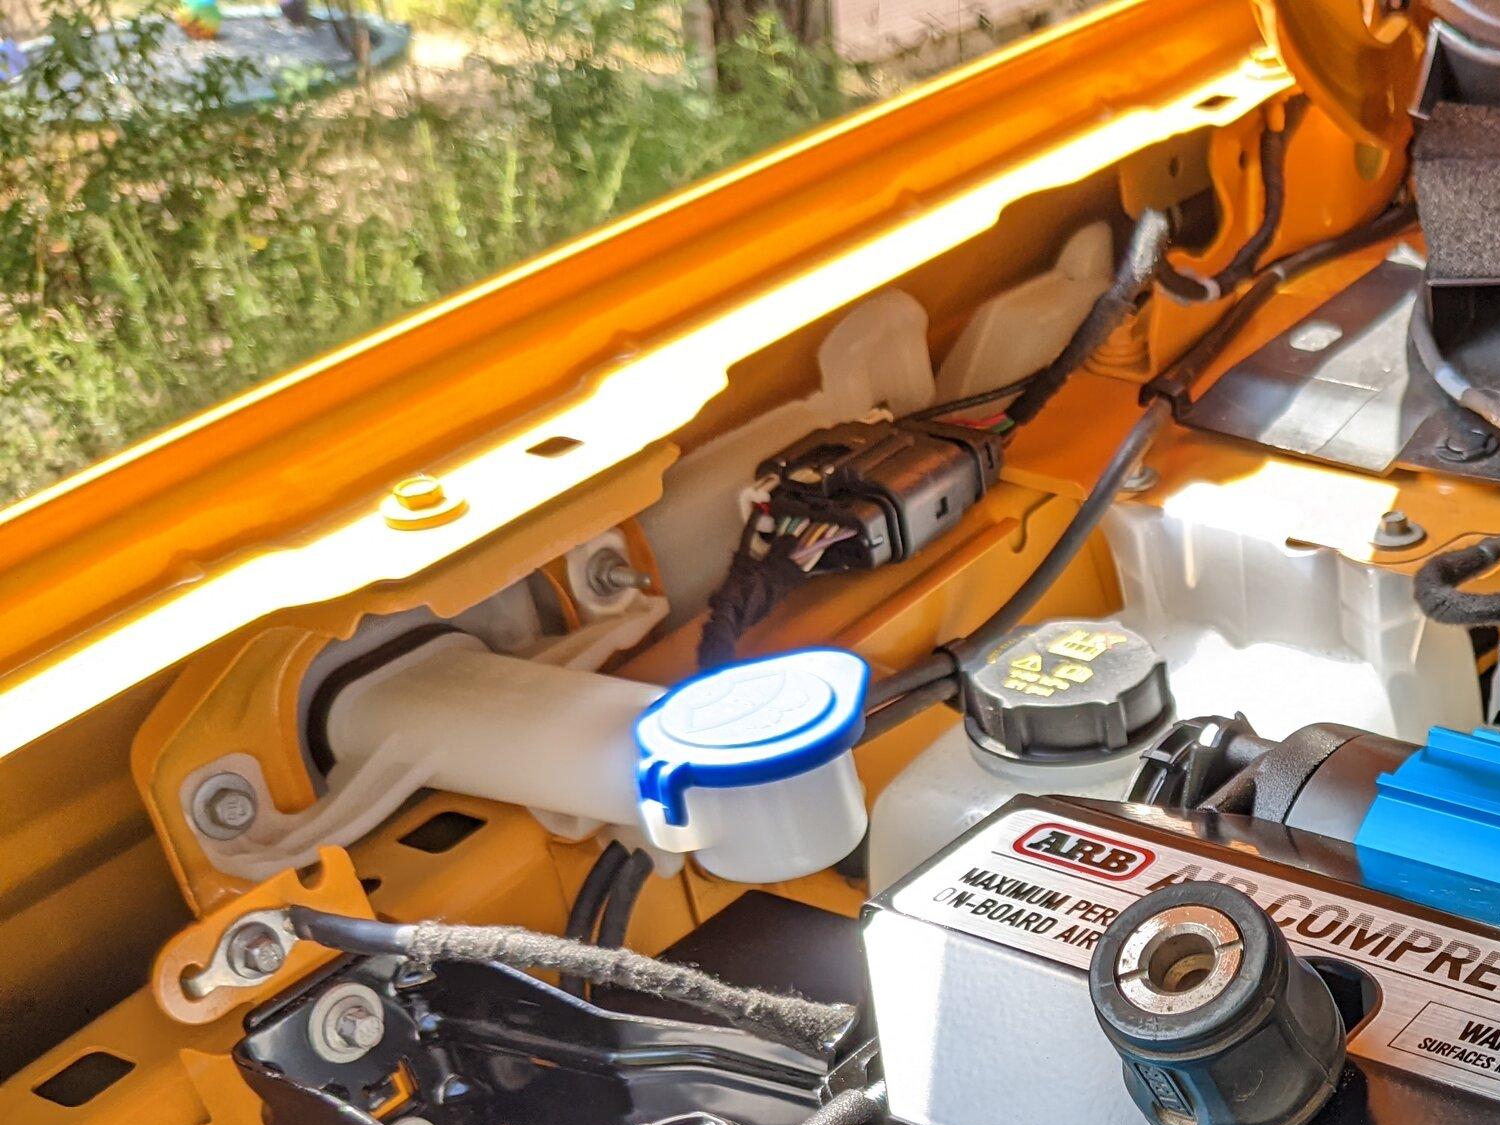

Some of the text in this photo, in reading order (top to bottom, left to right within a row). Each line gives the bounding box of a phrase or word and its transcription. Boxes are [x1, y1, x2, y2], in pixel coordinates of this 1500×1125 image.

[1028, 831, 1138, 873] ARB
[933, 887, 1102, 950] ON-BOARD AIR
[959, 868, 1119, 927] MAXIMUM PER
[1418, 1038, 1495, 1069] SURFACES
